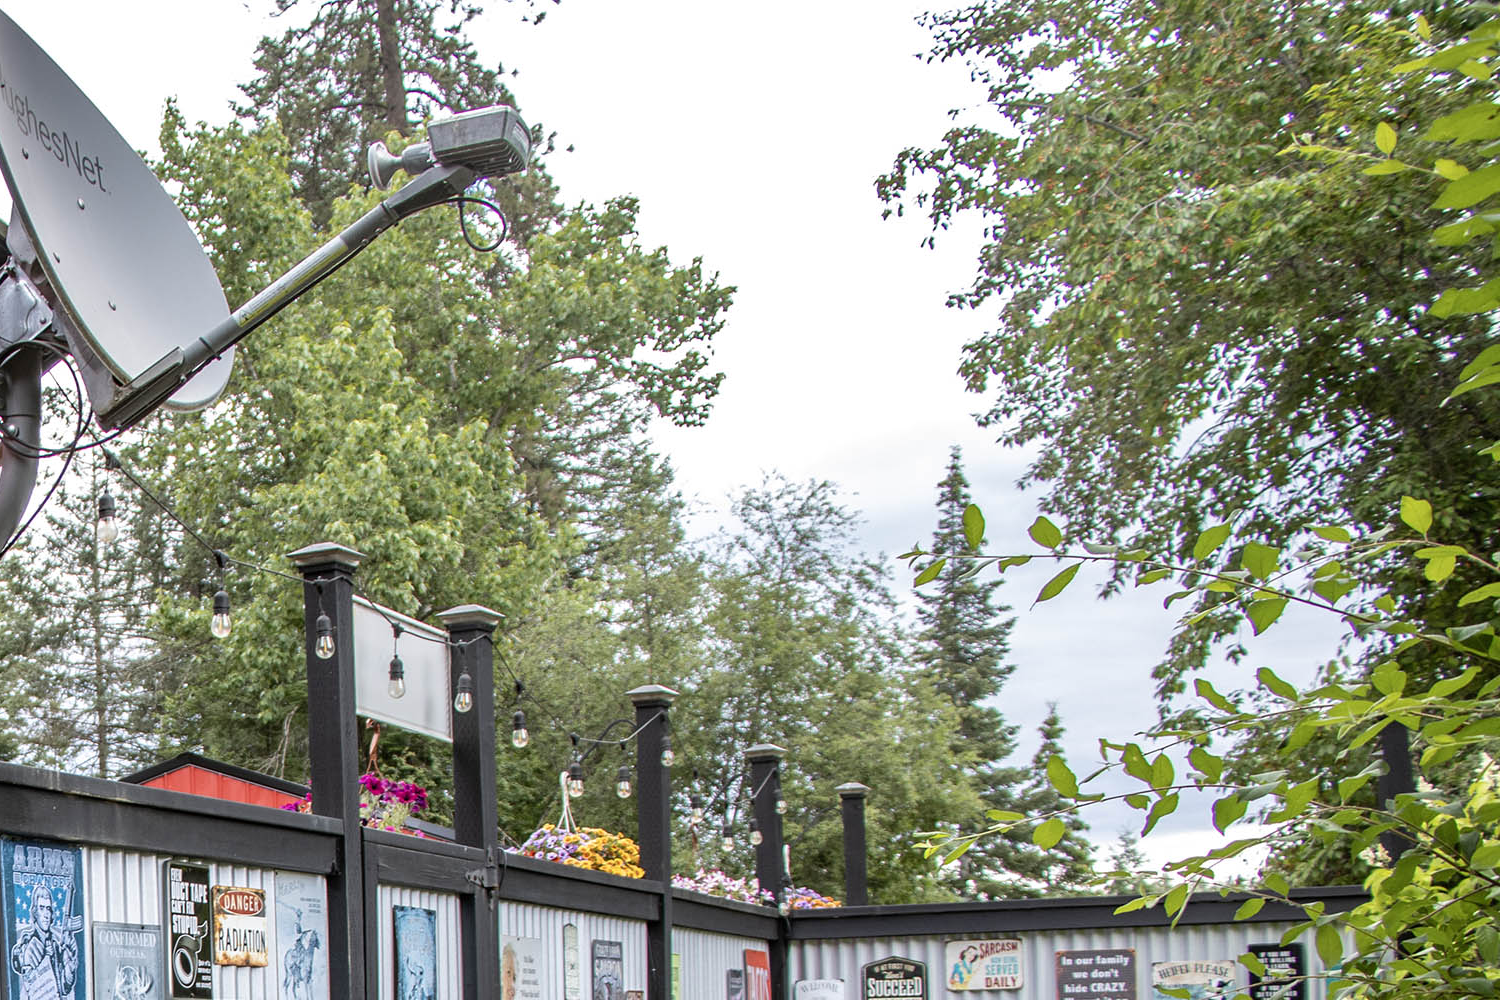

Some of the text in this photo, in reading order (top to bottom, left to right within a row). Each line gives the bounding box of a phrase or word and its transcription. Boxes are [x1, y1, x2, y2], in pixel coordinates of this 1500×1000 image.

[190, 883, 208, 903] TAPE
[224, 895, 260, 912] DANGER
[99, 930, 157, 948] CONFIRMED
[218, 929, 267, 953] RADIATION
[980, 942, 1018, 959] SARCASM
[1061, 957, 1073, 965] In
[1095, 955, 1129, 966] family
[985, 964, 1018, 975] SERVED
[1091, 969, 1119, 978] don't
[1194, 963, 1229, 977] PLEASE
[801, 983, 839, 992] WELCOME
[868, 976, 923, 997] SUCCEED
[985, 976, 1018, 987] DAILY
[1064, 982, 1128, 993] hide CRAZY.
